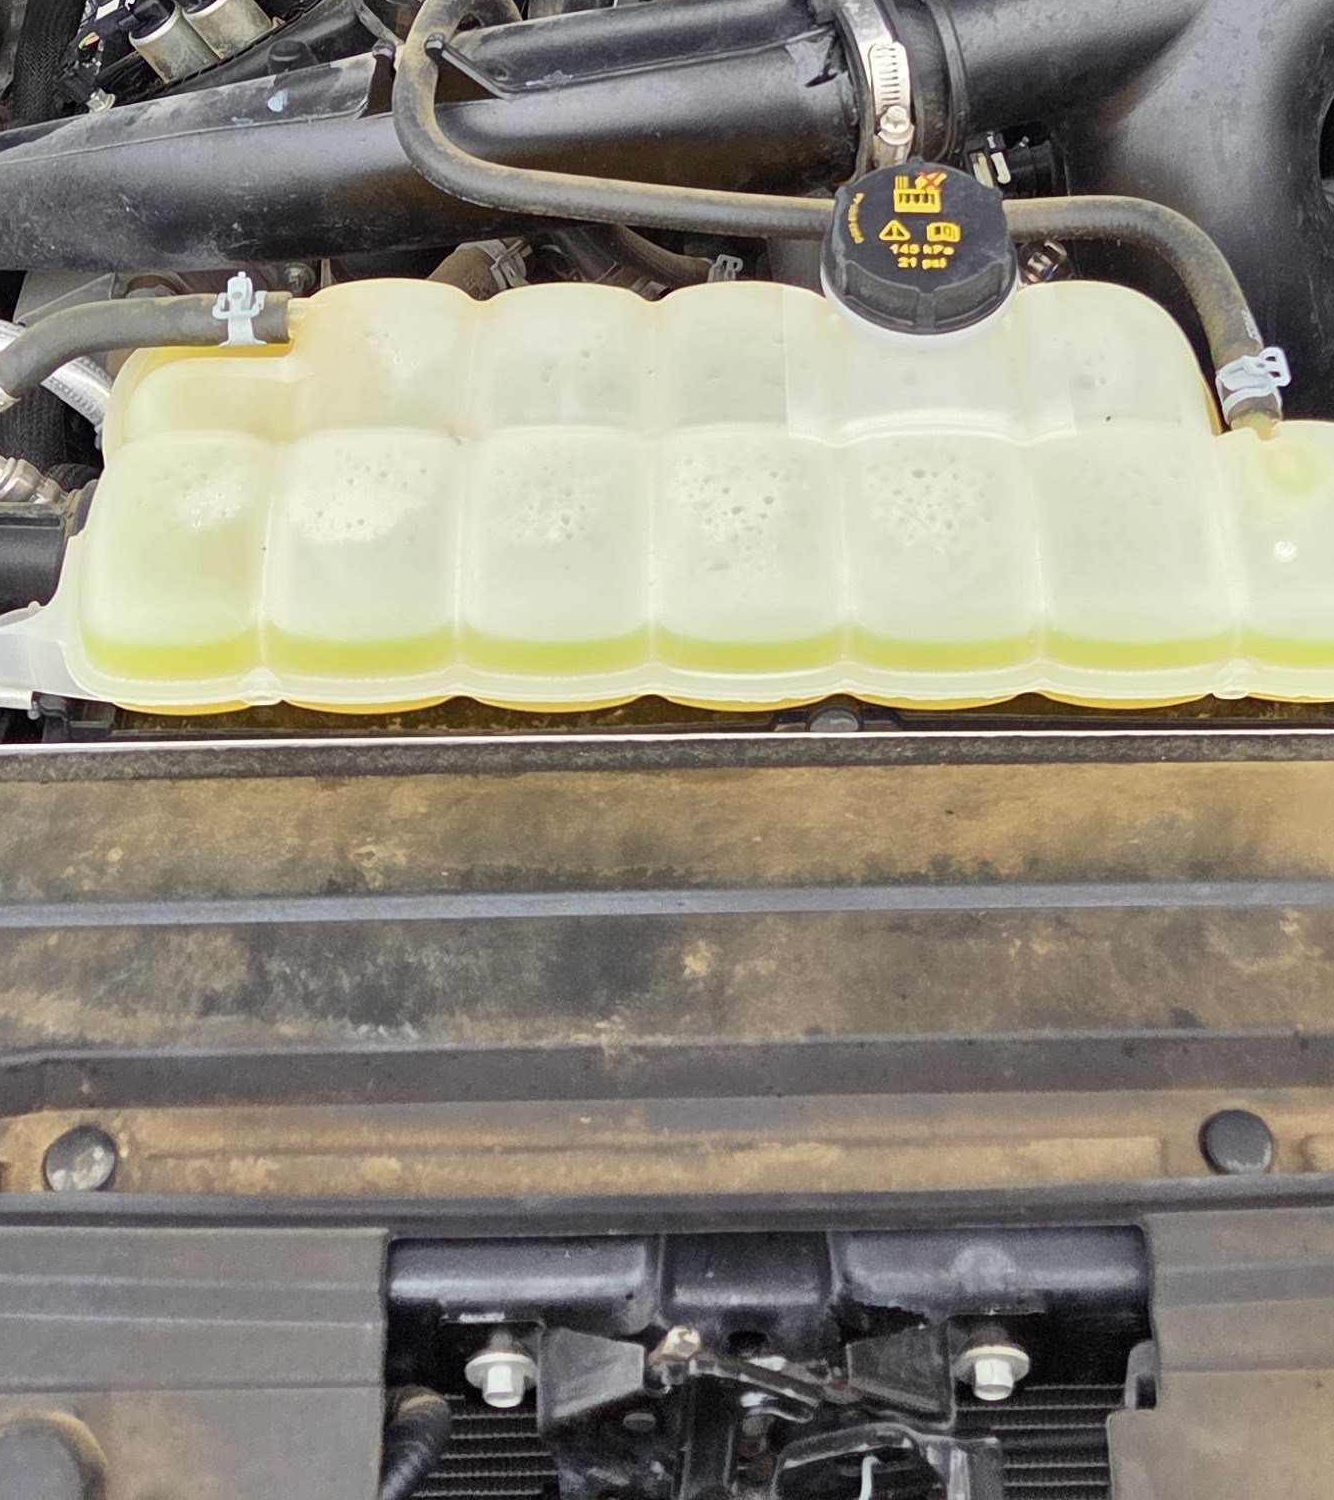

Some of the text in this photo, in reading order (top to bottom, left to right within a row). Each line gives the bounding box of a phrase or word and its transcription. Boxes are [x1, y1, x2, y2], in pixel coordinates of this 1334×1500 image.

[890, 244, 954, 255] 145 kPa
[897, 258, 947, 270] 21 psi
